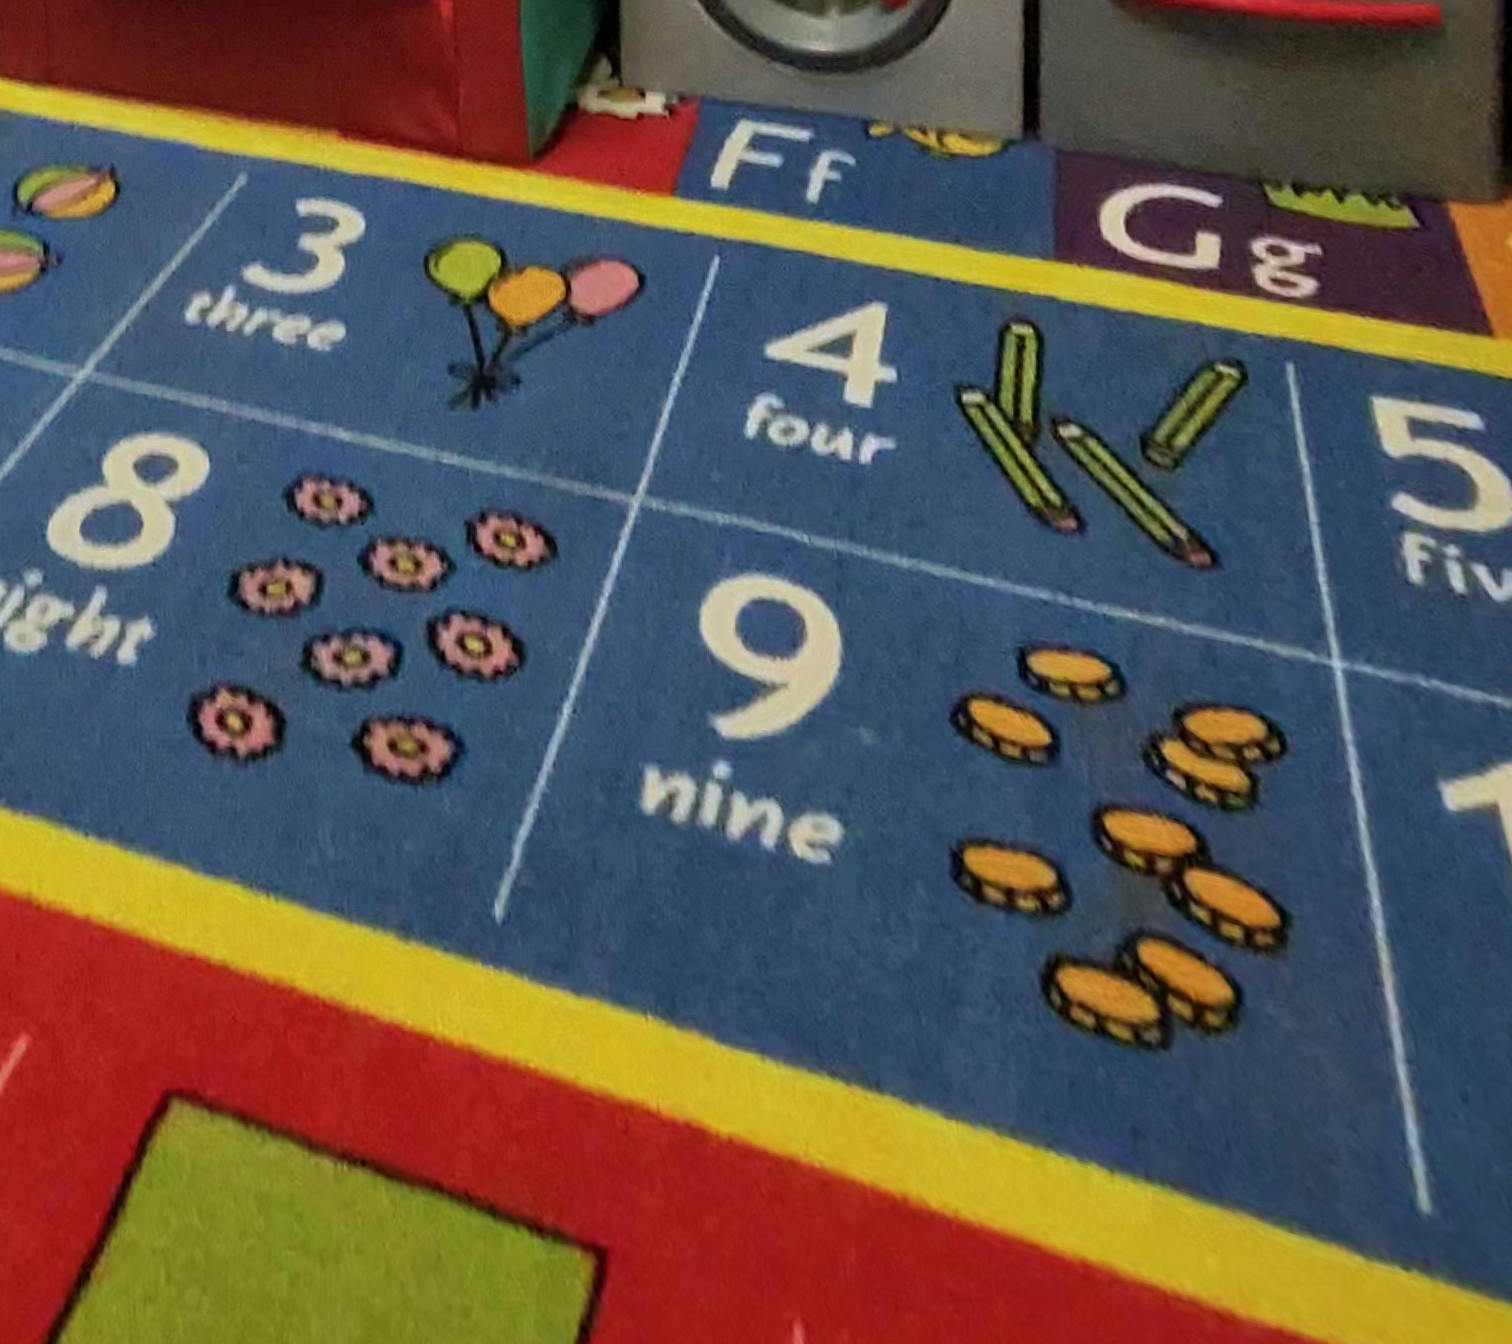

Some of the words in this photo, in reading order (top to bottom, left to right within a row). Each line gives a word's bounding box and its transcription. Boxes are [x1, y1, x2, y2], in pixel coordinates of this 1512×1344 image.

[241, 196, 367, 295] 3
[184, 284, 348, 353] three
[763, 300, 900, 410] 4
[742, 391, 897, 466] four
[1369, 395, 1512, 533] 5
[45, 431, 212, 570] 8
[698, 572, 844, 742] 9
[639, 760, 845, 866] nine
